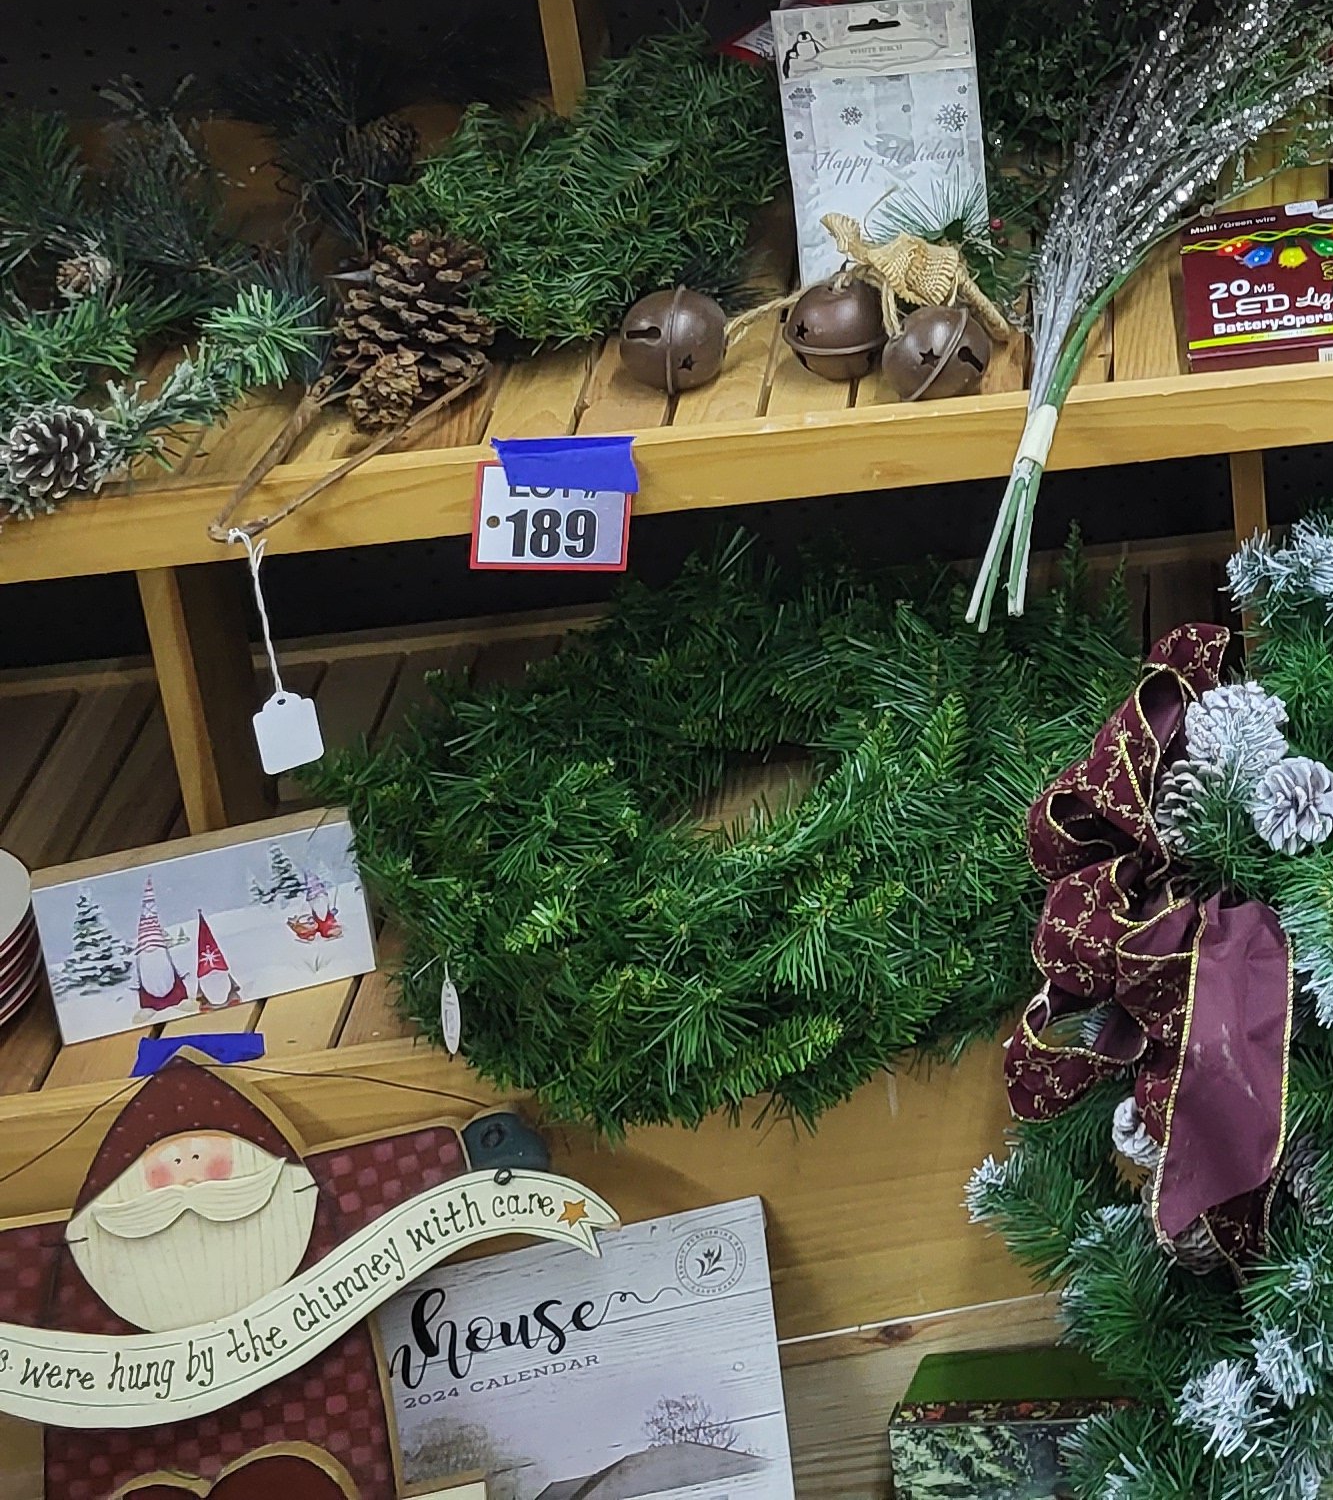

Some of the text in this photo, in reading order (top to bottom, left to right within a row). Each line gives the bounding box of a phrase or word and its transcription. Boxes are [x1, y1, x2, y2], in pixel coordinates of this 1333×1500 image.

[812, 138, 966, 185] Happy Holidays
[1255, 214, 1276, 225] wire
[1209, 279, 1275, 301] 20 M5
[1211, 293, 1290, 319] LED
[505, 508, 598, 559] 189
[107, 1351, 176, 1400] hung
[186, 1339, 215, 1387] by
[226, 1318, 288, 1363] the
[292, 1237, 405, 1332] chimney
[406, 1191, 487, 1252] with
[492, 1192, 556, 1219] care
[404, 1354, 601, 1409] 2024 CALENDAR
